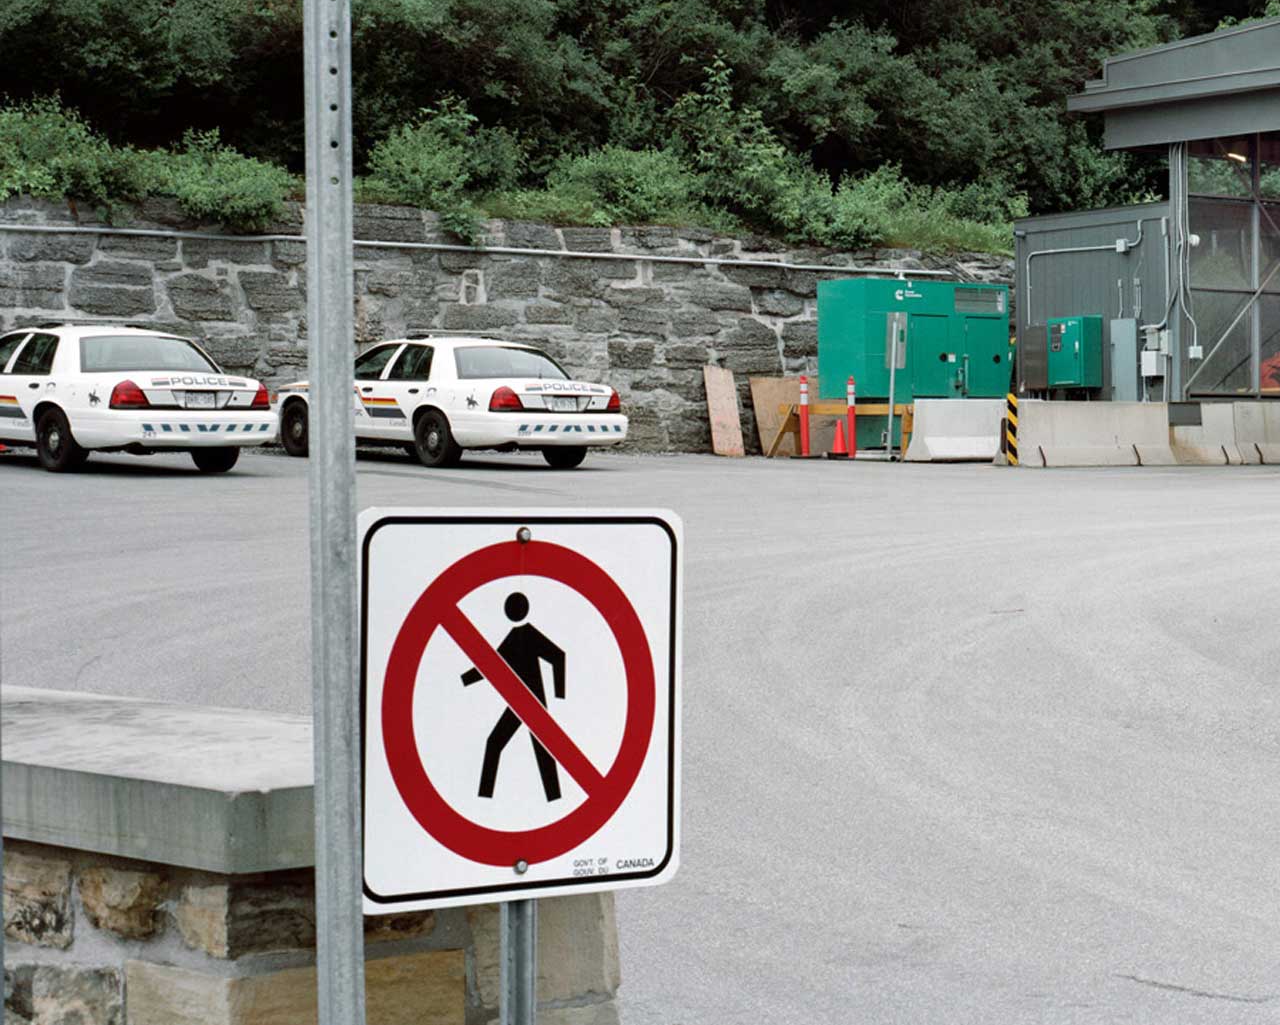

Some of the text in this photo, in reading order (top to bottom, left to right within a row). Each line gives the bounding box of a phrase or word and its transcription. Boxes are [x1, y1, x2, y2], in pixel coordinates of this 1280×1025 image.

[171, 377, 227, 386] POLICE
[542, 383, 591, 391] POLICE
[598, 857, 608, 865] OF
[616, 857, 655, 869] CANADA
[598, 866, 609, 874] DU
